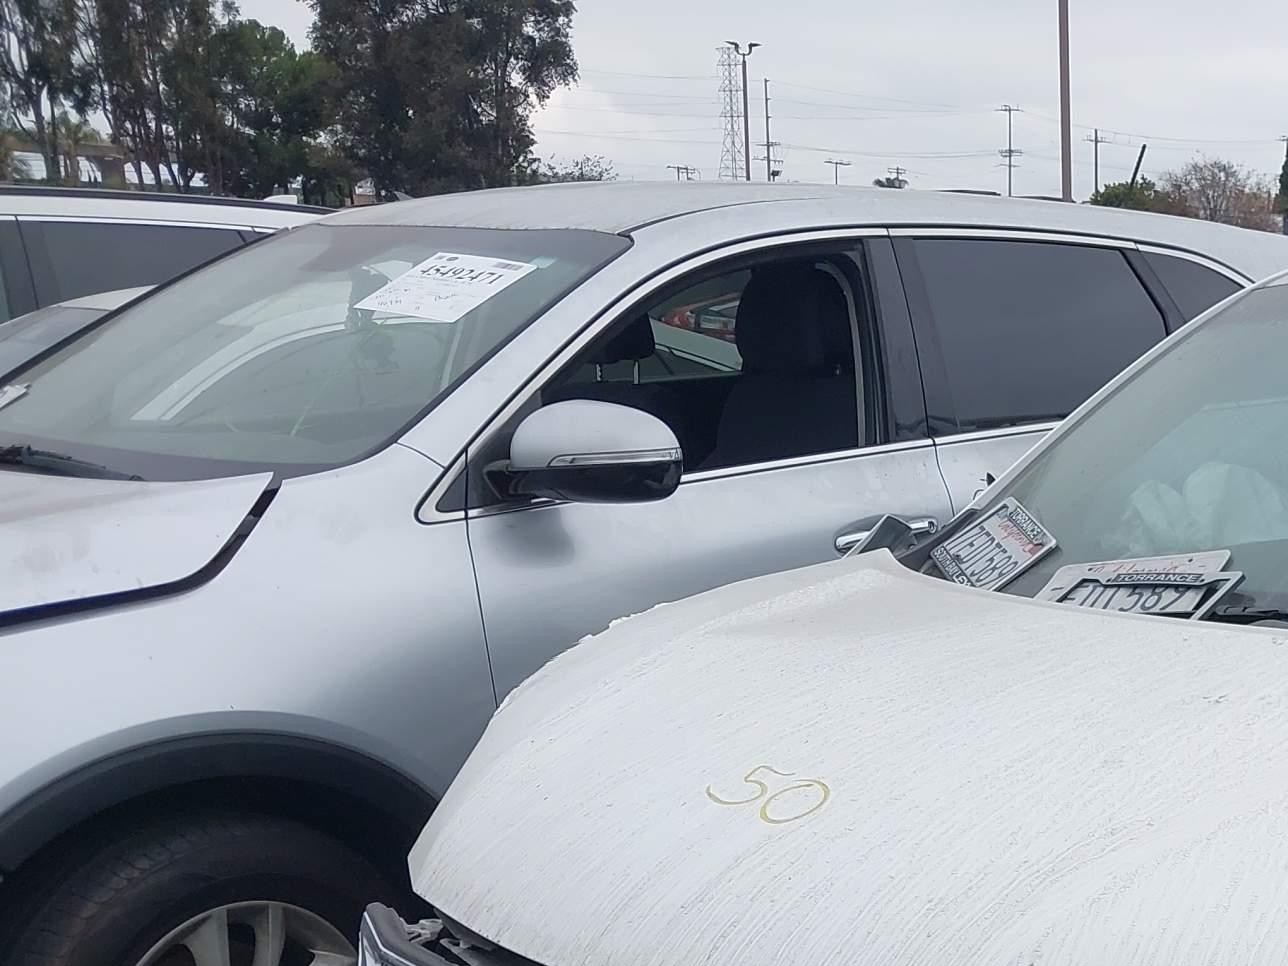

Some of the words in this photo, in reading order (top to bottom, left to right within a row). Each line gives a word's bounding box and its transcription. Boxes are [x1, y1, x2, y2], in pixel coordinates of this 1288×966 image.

[420, 264, 504, 285] 45492471
[1009, 507, 1042, 540] TORRANCE
[944, 525, 1020, 591] 7EDT589
[1116, 573, 1201, 583] TORRANCE
[705, 764, 831, 825] 50
